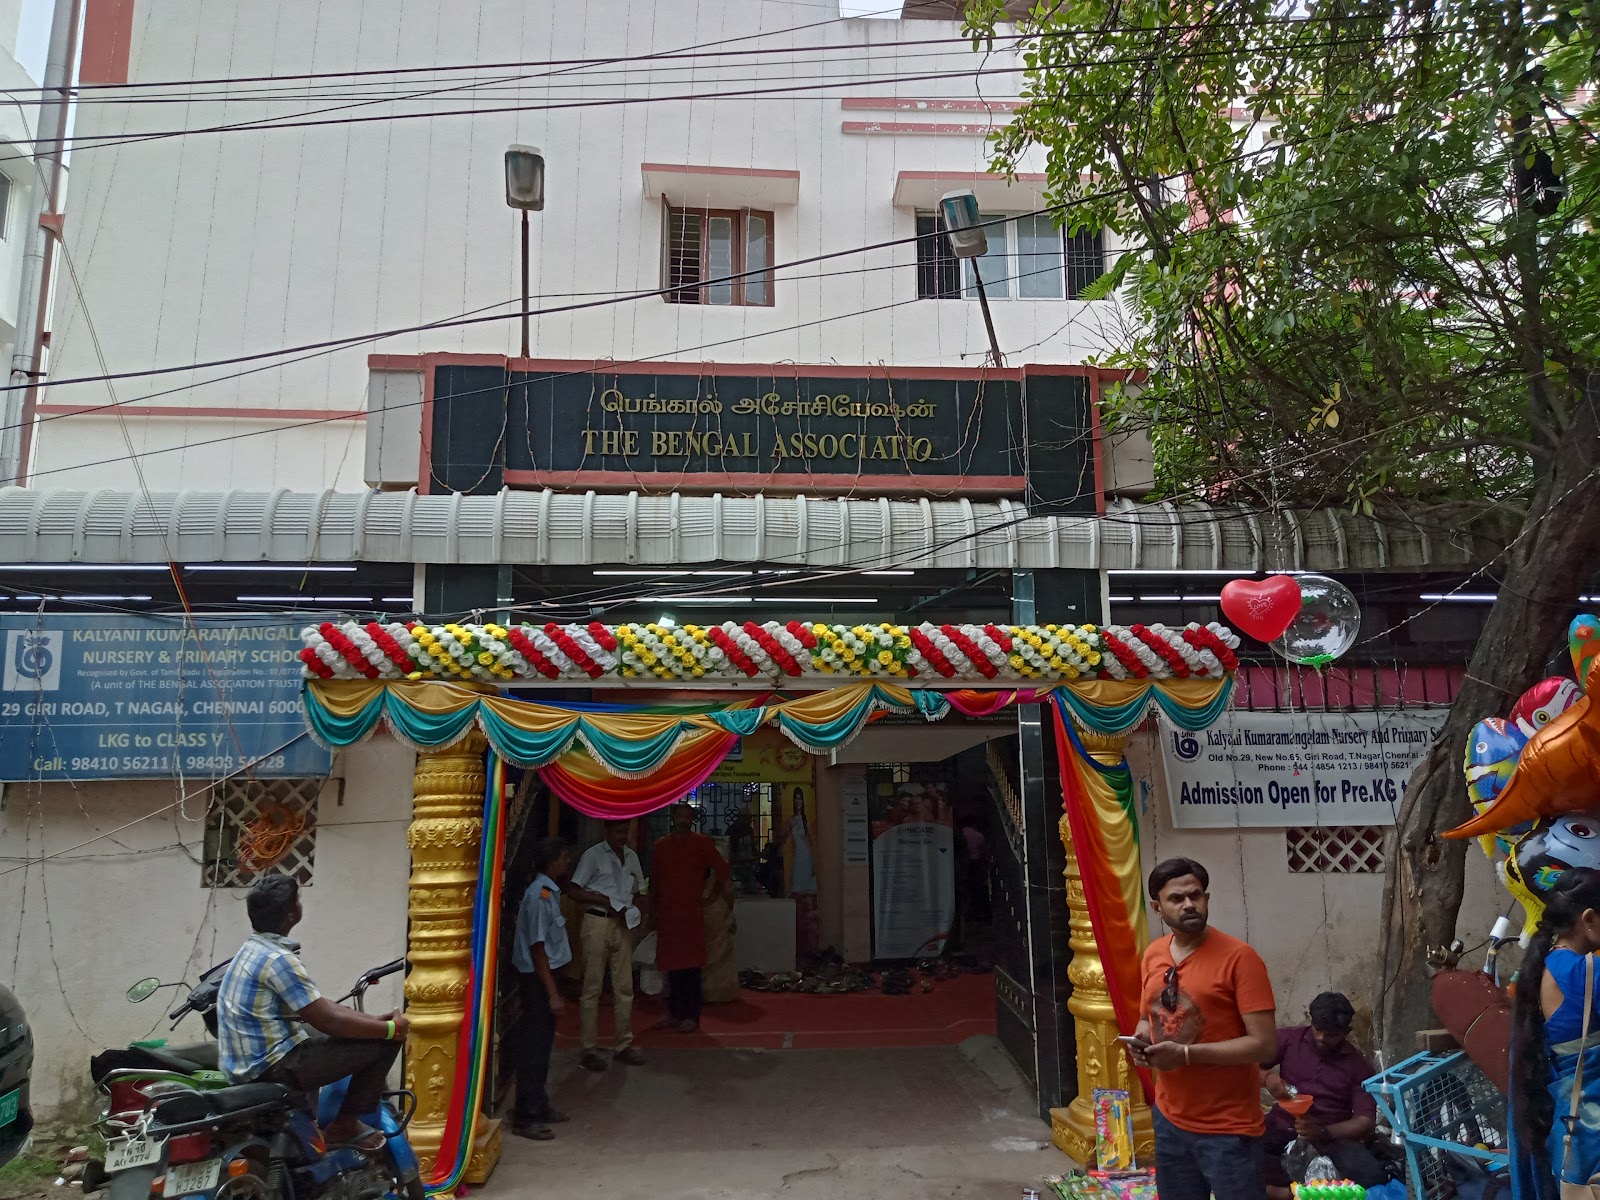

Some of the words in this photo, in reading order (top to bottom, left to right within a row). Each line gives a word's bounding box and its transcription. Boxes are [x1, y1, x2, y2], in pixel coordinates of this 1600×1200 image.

[600, 389, 723, 414] பெங்கால்
[581, 430, 639, 456] THE
[650, 431, 759, 458] BENGAL
[73, 629, 140, 642] KALYANI
[83, 650, 156, 664] NURSERY
[158, 651, 170, 663] &
[175, 650, 246, 663] PRIMARY
[78, 669, 117, 677] Recognised
[120, 669, 128, 677] by
[104, 681, 122, 689] unit
[1, 703, 20, 716] 29
[24, 702, 57, 716] GIRI
[61, 702, 110, 717] ROAD,
[115, 702, 124, 715] T
[128, 701, 188, 717] NAGAR,
[193, 701, 264, 714] CHENNAI
[99, 733, 130, 747] LKG
[135, 735, 151, 747] to
[157, 732, 207, 747] CLASS
[212, 732, 224, 747] V
[1206, 728, 1243, 750] Kalyani
[1244, 728, 1330, 750] Kumaramangalam
[1332, 728, 1368, 748] Nursery
[1371, 727, 1390, 744] And
[1391, 726, 1428, 747] Primary
[33, 756, 67, 771] Call:
[72, 757, 118, 770] 98410
[123, 756, 168, 770] 56211
[1208, 753, 1224, 761] Old
[1255, 753, 1273, 761] New
[1304, 753, 1320, 761] Giri
[1322, 752, 1347, 762] Road,
[1258, 763, 1286, 771] Phone
[1337, 762, 1358, 770] 1213
[1180, 781, 1264, 805] Admission
[1268, 780, 1310, 810] Open
[1315, 779, 1337, 804] for
[1341, 778, 1398, 804] Pre.KG
